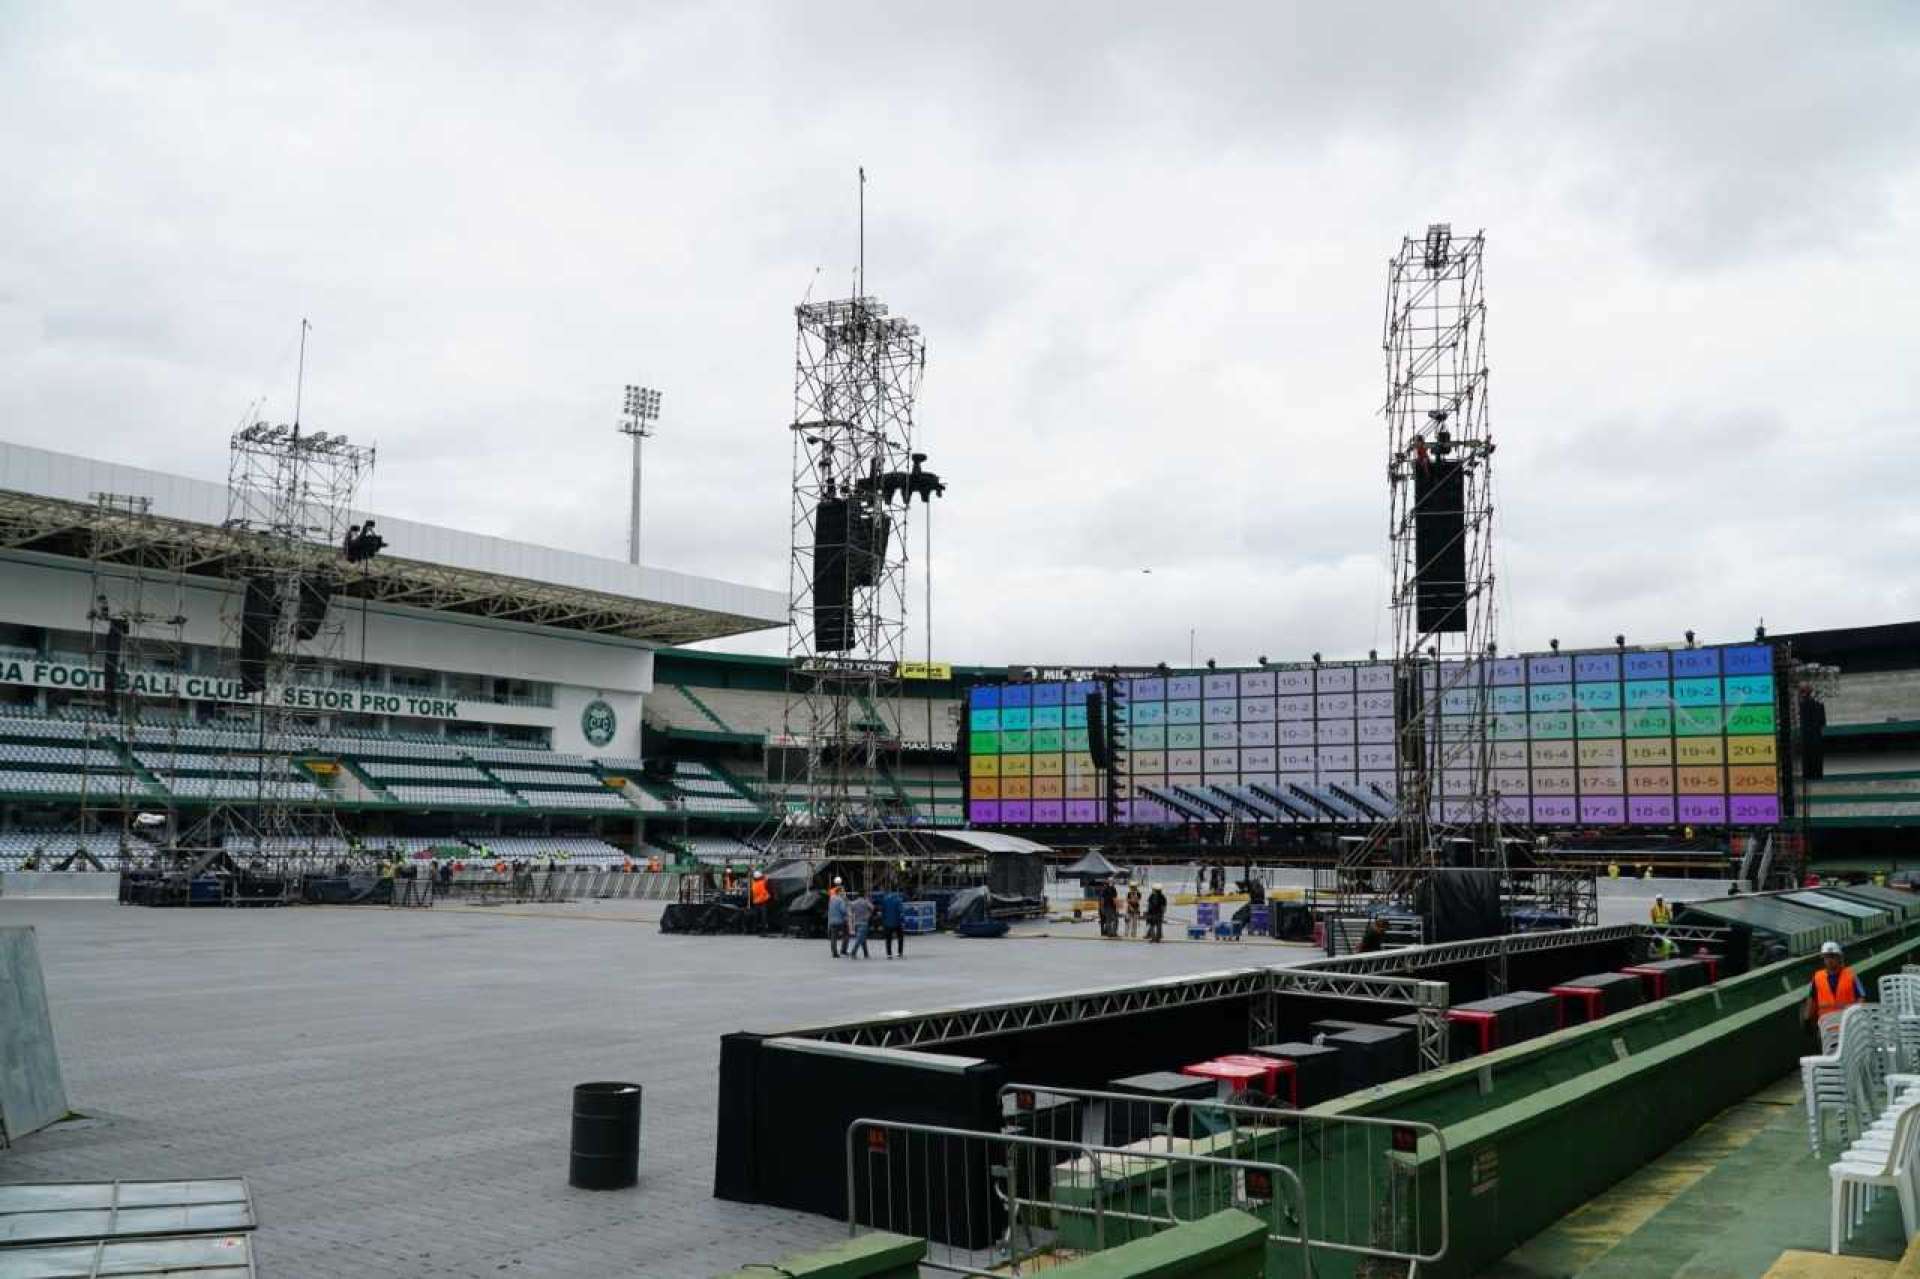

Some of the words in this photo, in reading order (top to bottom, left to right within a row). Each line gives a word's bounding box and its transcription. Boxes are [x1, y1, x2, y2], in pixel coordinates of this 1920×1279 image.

[1535, 663, 1565, 674] 16-1
[1579, 661, 1611, 673] 17-1
[34, 664, 105, 688] FOOT
[1579, 690, 1612, 701] 17-2
[1679, 686, 1714, 697] 19-2
[284, 687, 354, 709] SETOR
[360, 694, 400, 713] PRO
[406, 698, 458, 718] TORK
[1731, 714, 1772, 726] 20-3
[1536, 749, 1569, 760] 16-4
[1681, 745, 1717, 757] 19-4
[1733, 744, 1773, 756] 20-4
[1583, 777, 1617, 787] 17-5
[1634, 776, 1669, 787] 18-5
[1682, 776, 1719, 787] 19-5
[1735, 775, 1775, 787] 20-5
[1537, 806, 1571, 817] 16-6
[1583, 806, 1618, 817] 17-6
[1683, 806, 1720, 817] 19-6
[1736, 805, 1776, 817] 20-6
